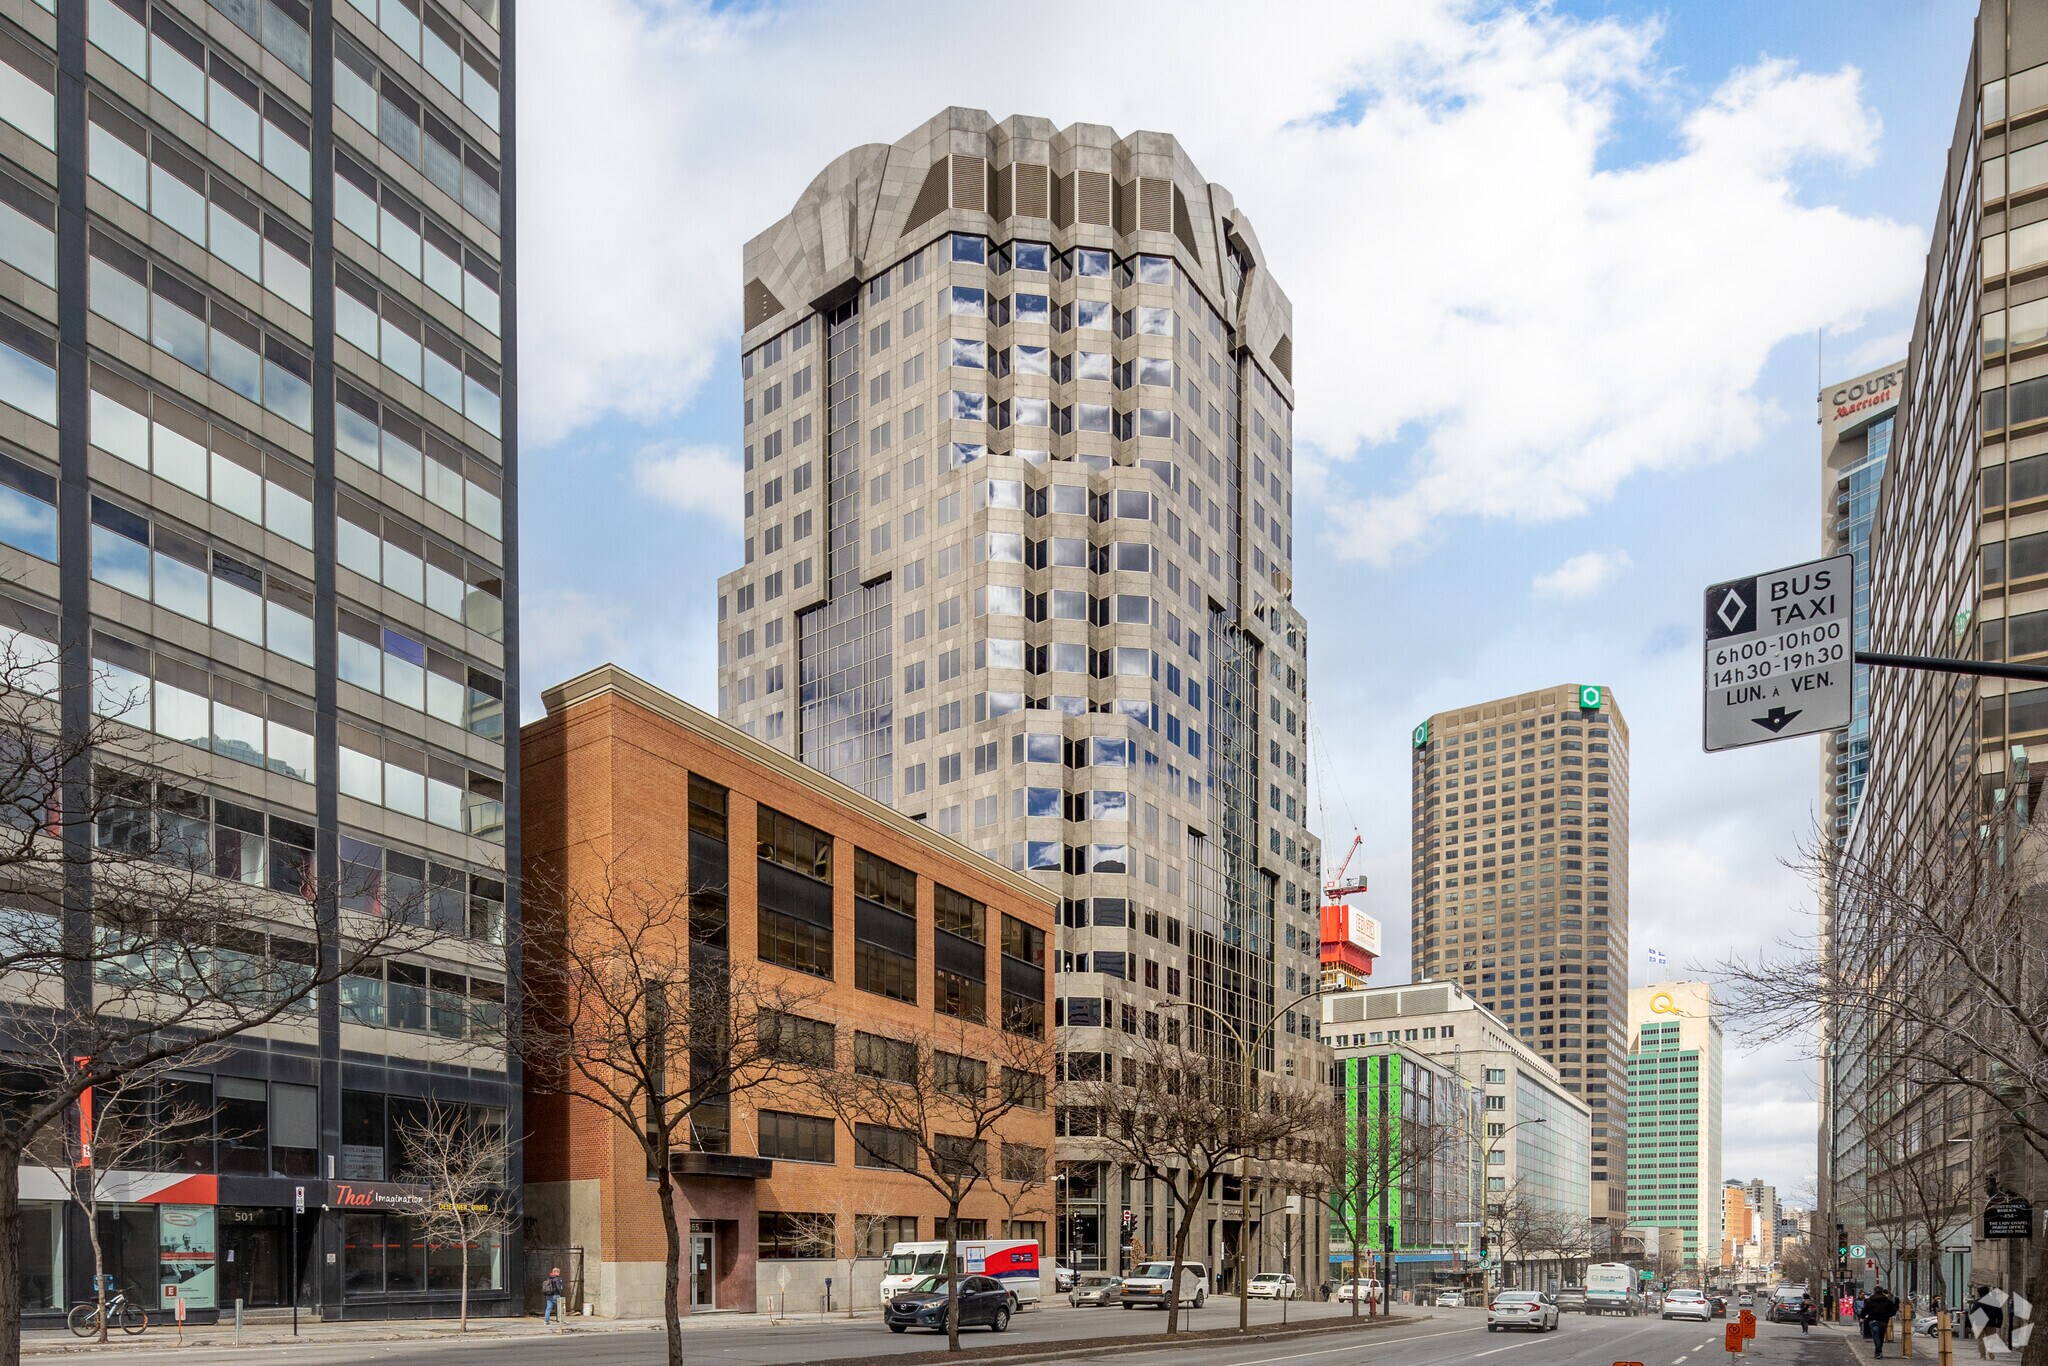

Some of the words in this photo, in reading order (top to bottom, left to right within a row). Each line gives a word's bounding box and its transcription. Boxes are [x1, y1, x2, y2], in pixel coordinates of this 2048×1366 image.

[1833, 389, 1891, 421] Marriott
[1770, 570, 1831, 602] BUS
[1770, 594, 1835, 626] TAXI
[1715, 622, 1840, 666] 6h00-10h00
[1713, 644, 1844, 688] 14h30-19h30
[1726, 685, 1766, 706] LUN.
[1791, 671, 1834, 693] VEN.
[336, 1185, 374, 1206] Thai
[375, 1192, 424, 1207] Imagination
[234, 1212, 253, 1222] 501
[690, 1223, 700, 1232] 65
